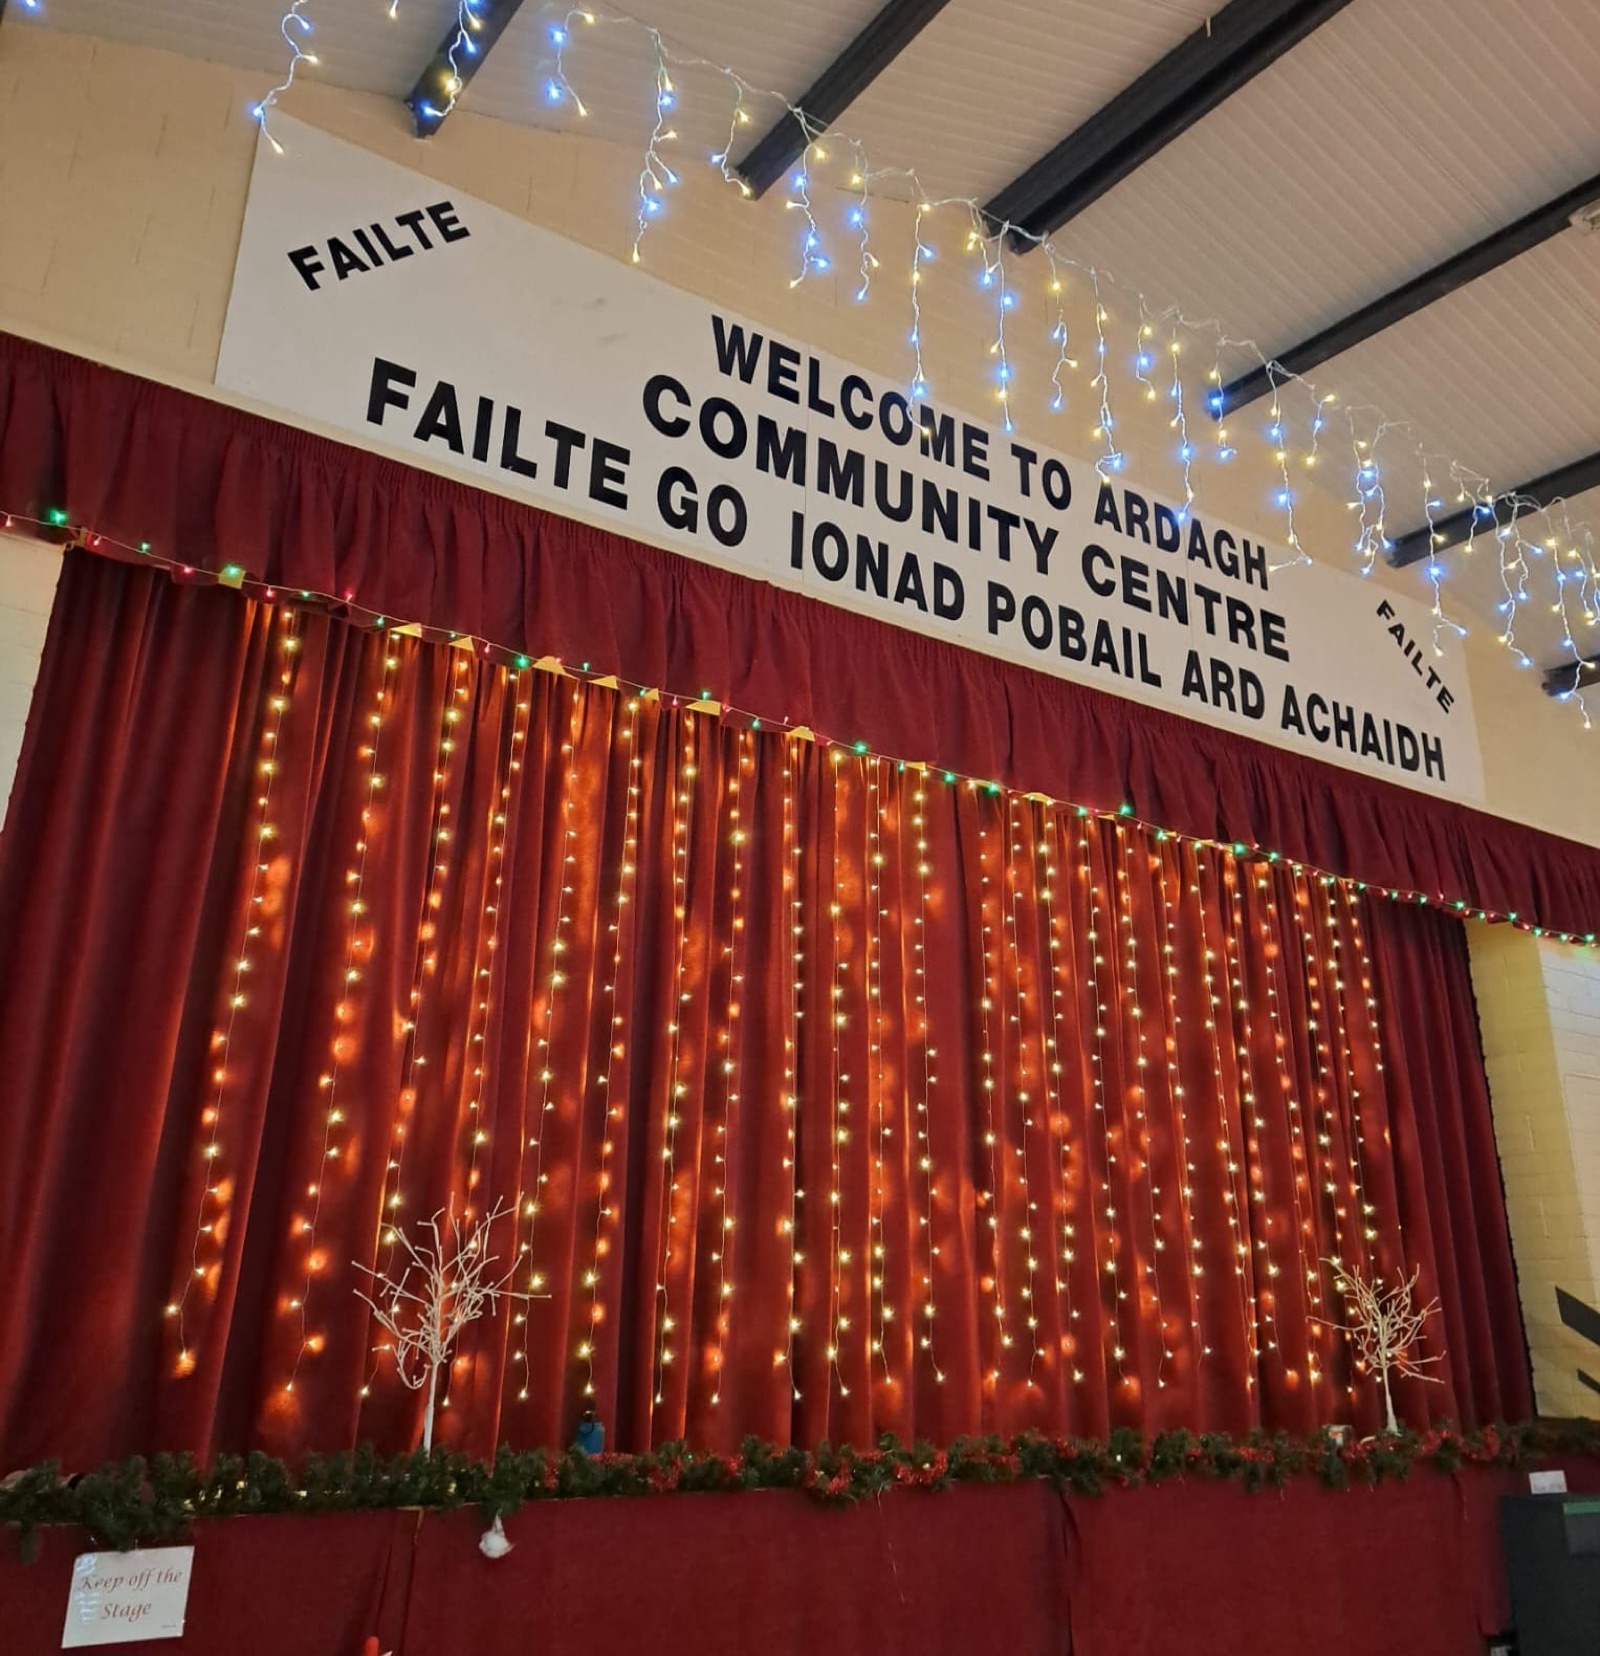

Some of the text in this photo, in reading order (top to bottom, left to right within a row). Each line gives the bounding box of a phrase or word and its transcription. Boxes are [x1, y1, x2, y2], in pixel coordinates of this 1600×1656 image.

[288, 201, 471, 291] FAILTE
[711, 315, 1269, 591] WELCOME TO ARDAGH
[366, 357, 1446, 782] FAILTE GO IONAD POBAIL ARD ACHAIDH
[643, 374, 1290, 663] COMMUNITY CENTRE
[1376, 599, 1455, 714] FAILTE
[81, 1567, 182, 1593] Keep off the
[100, 1602, 152, 1623] Stage
